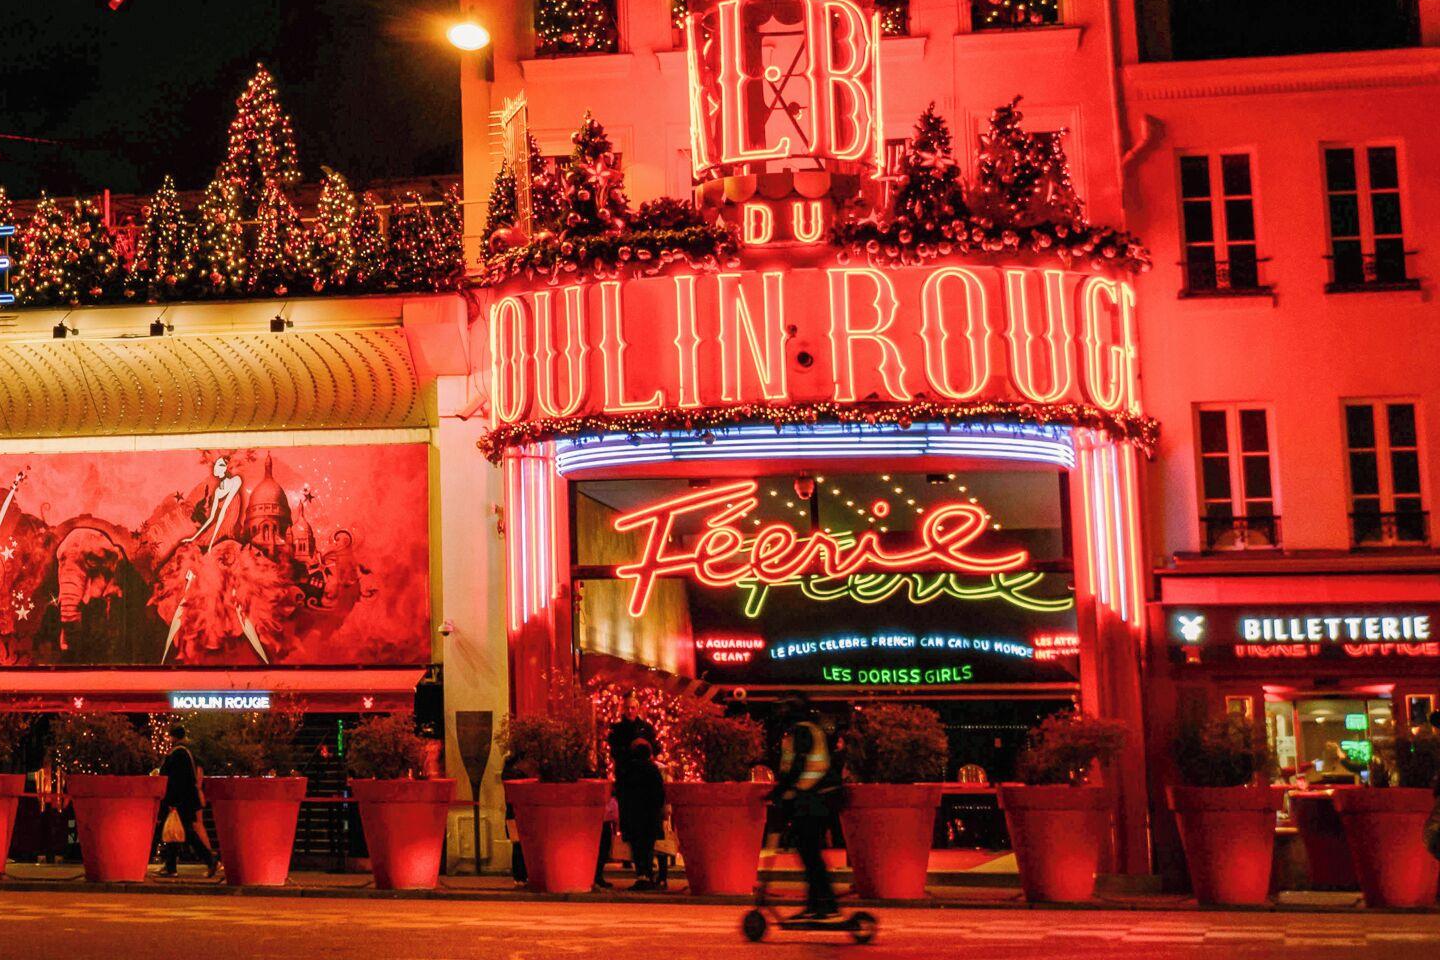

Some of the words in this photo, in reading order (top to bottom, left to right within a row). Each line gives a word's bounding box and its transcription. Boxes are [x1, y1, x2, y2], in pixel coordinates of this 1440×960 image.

[743, 202, 824, 245] DU
[613, 480, 1029, 618] Féerie
[1243, 616, 1431, 641] BILLETTERIE
[712, 652, 751, 661] GEANT
[770, 646, 785, 659] LE
[788, 642, 817, 655] PLUS
[819, 637, 868, 651] CELEBRE
[871, 636, 915, 647] FRENCH
[920, 637, 944, 647] CAN
[947, 638, 971, 649] CAN
[973, 640, 990, 651] DU
[994, 642, 1034, 658] MONDE
[823, 667, 852, 682] LES
[858, 669, 920, 683] DORISS
[925, 665, 972, 683] GIRLS
[173, 696, 223, 709] MOULIN
[224, 696, 271, 709] ROUGE
